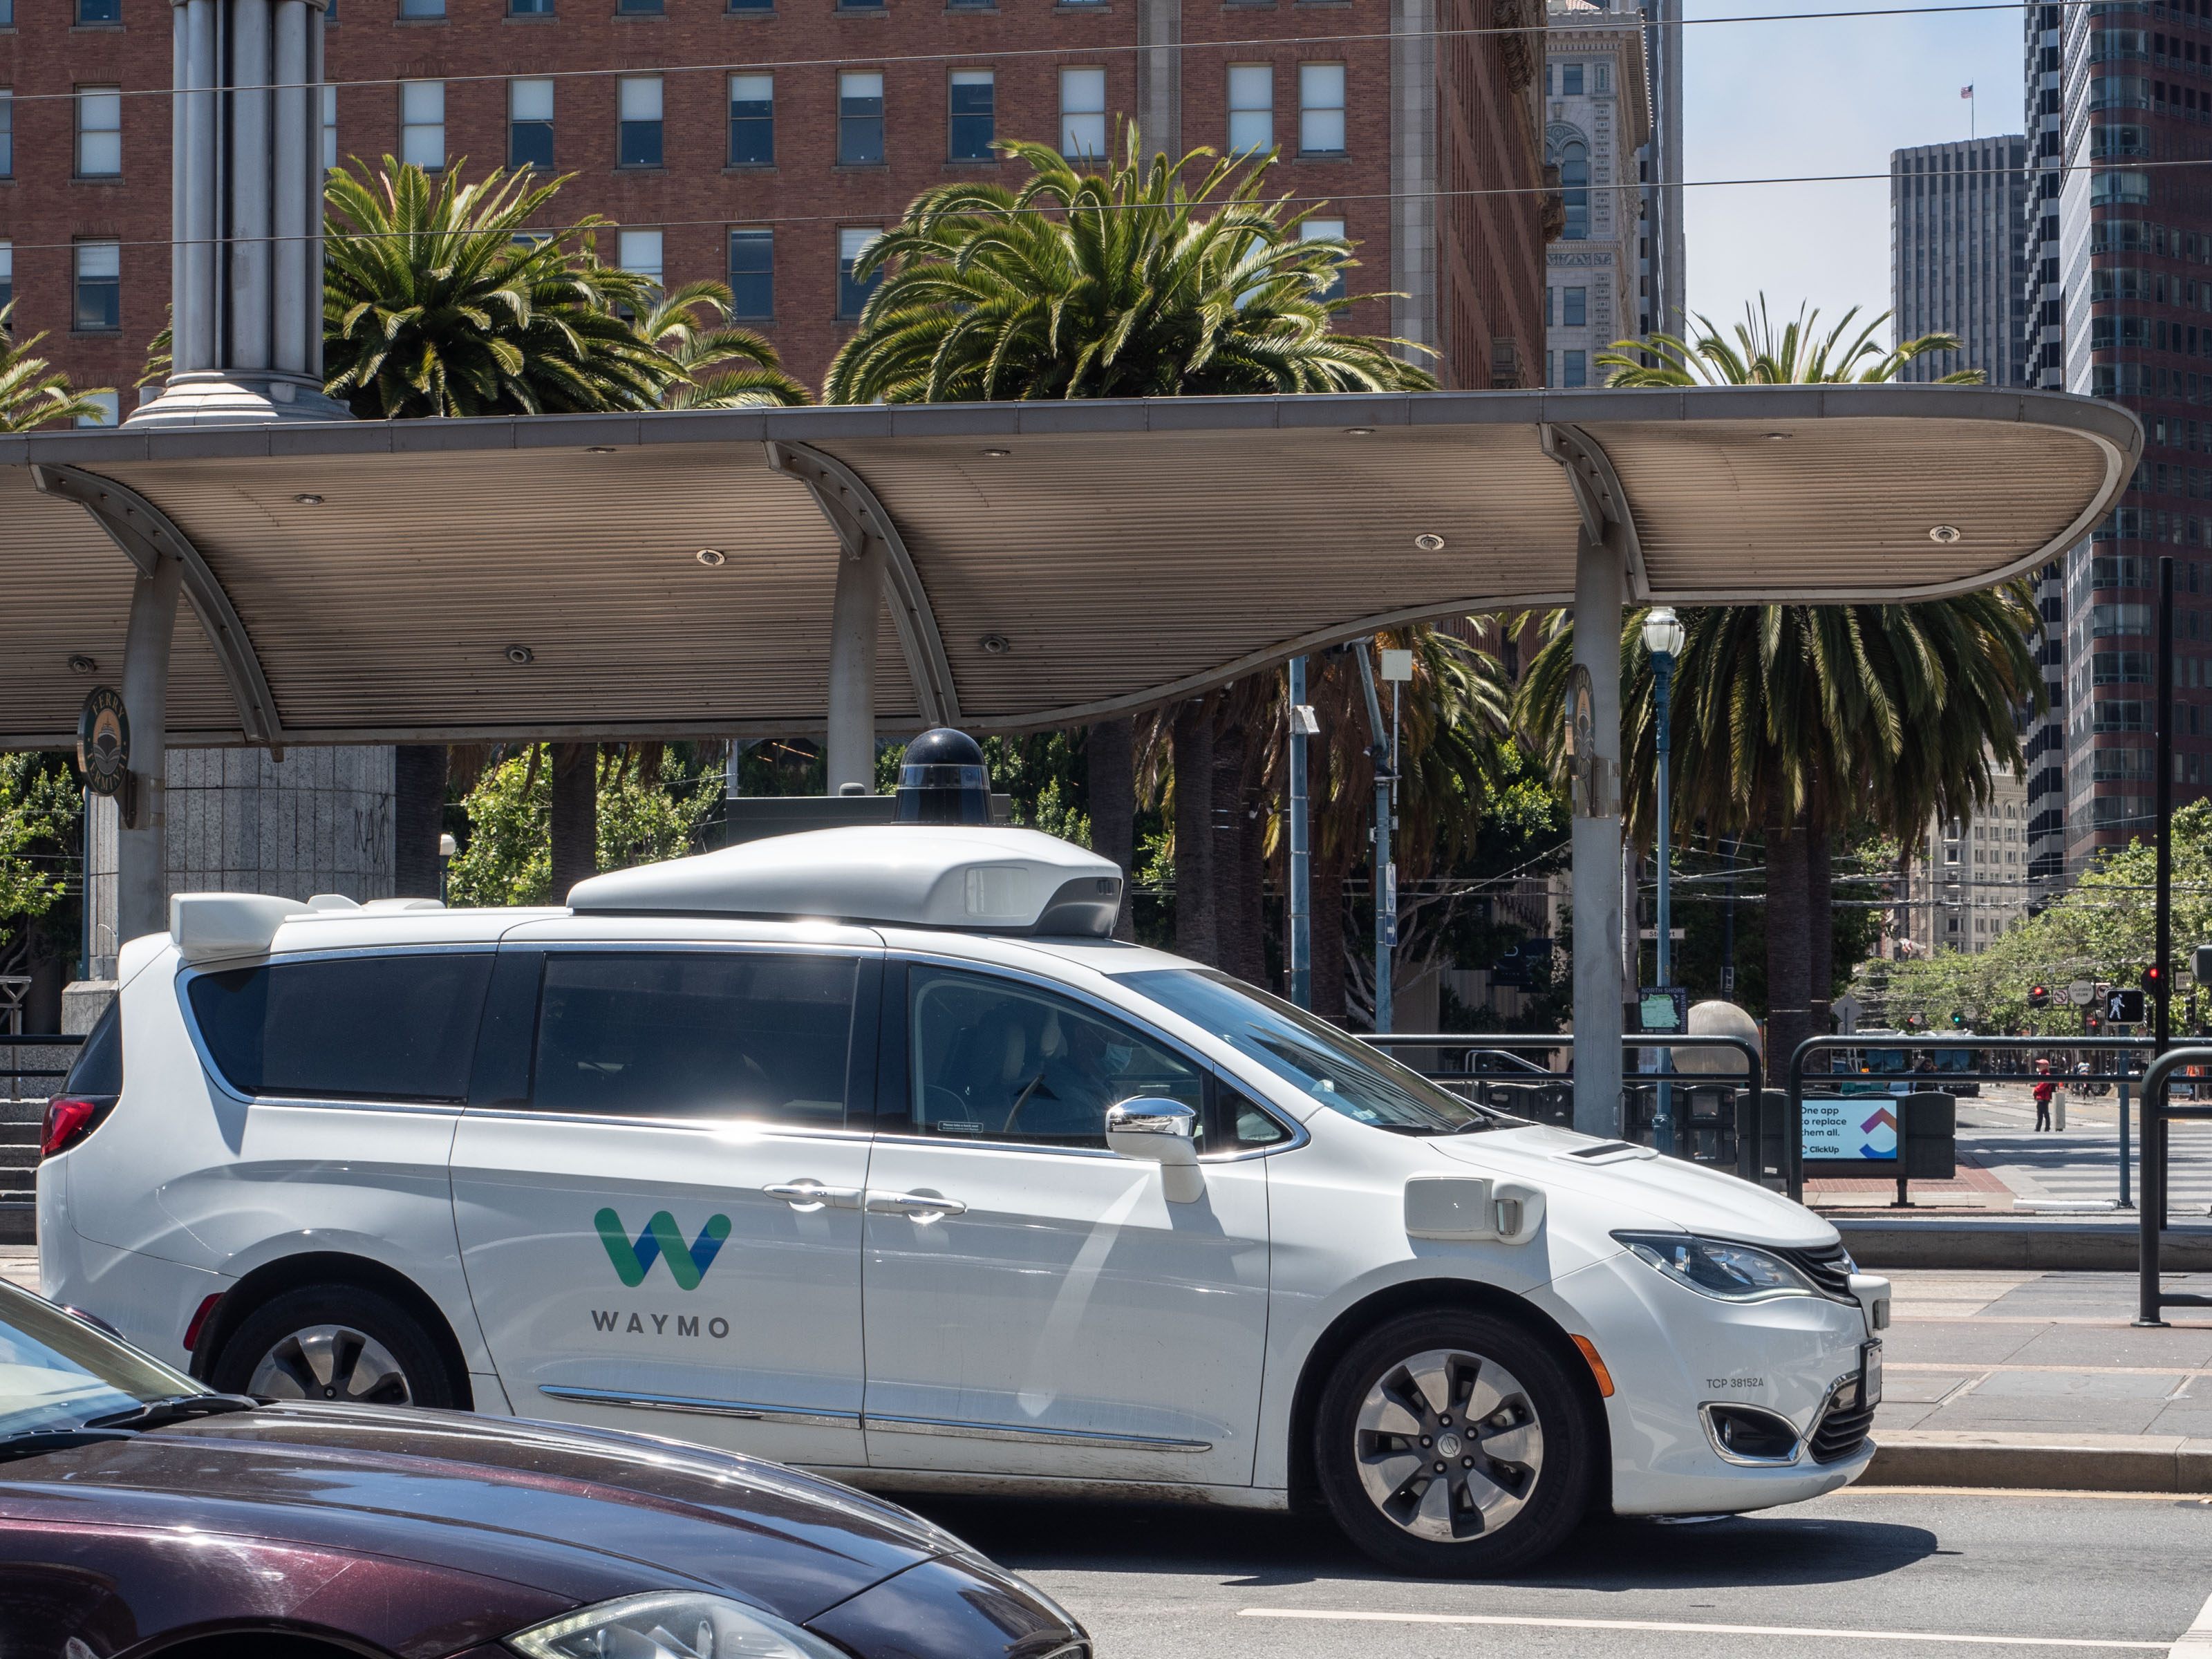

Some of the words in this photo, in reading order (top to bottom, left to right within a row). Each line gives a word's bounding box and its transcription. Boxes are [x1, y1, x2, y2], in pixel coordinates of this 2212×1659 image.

[92, 692, 125, 719] FERRY
[1821, 1107, 1839, 1116] app
[1812, 1118, 1847, 1127] replace
[1826, 1128, 1840, 1136] all.
[1809, 1145, 1840, 1154] ClickUp
[591, 1310, 729, 1339] WAYMO
[1706, 1378, 1727, 1389] TCP
[1730, 1377, 1764, 1388] 38152A
